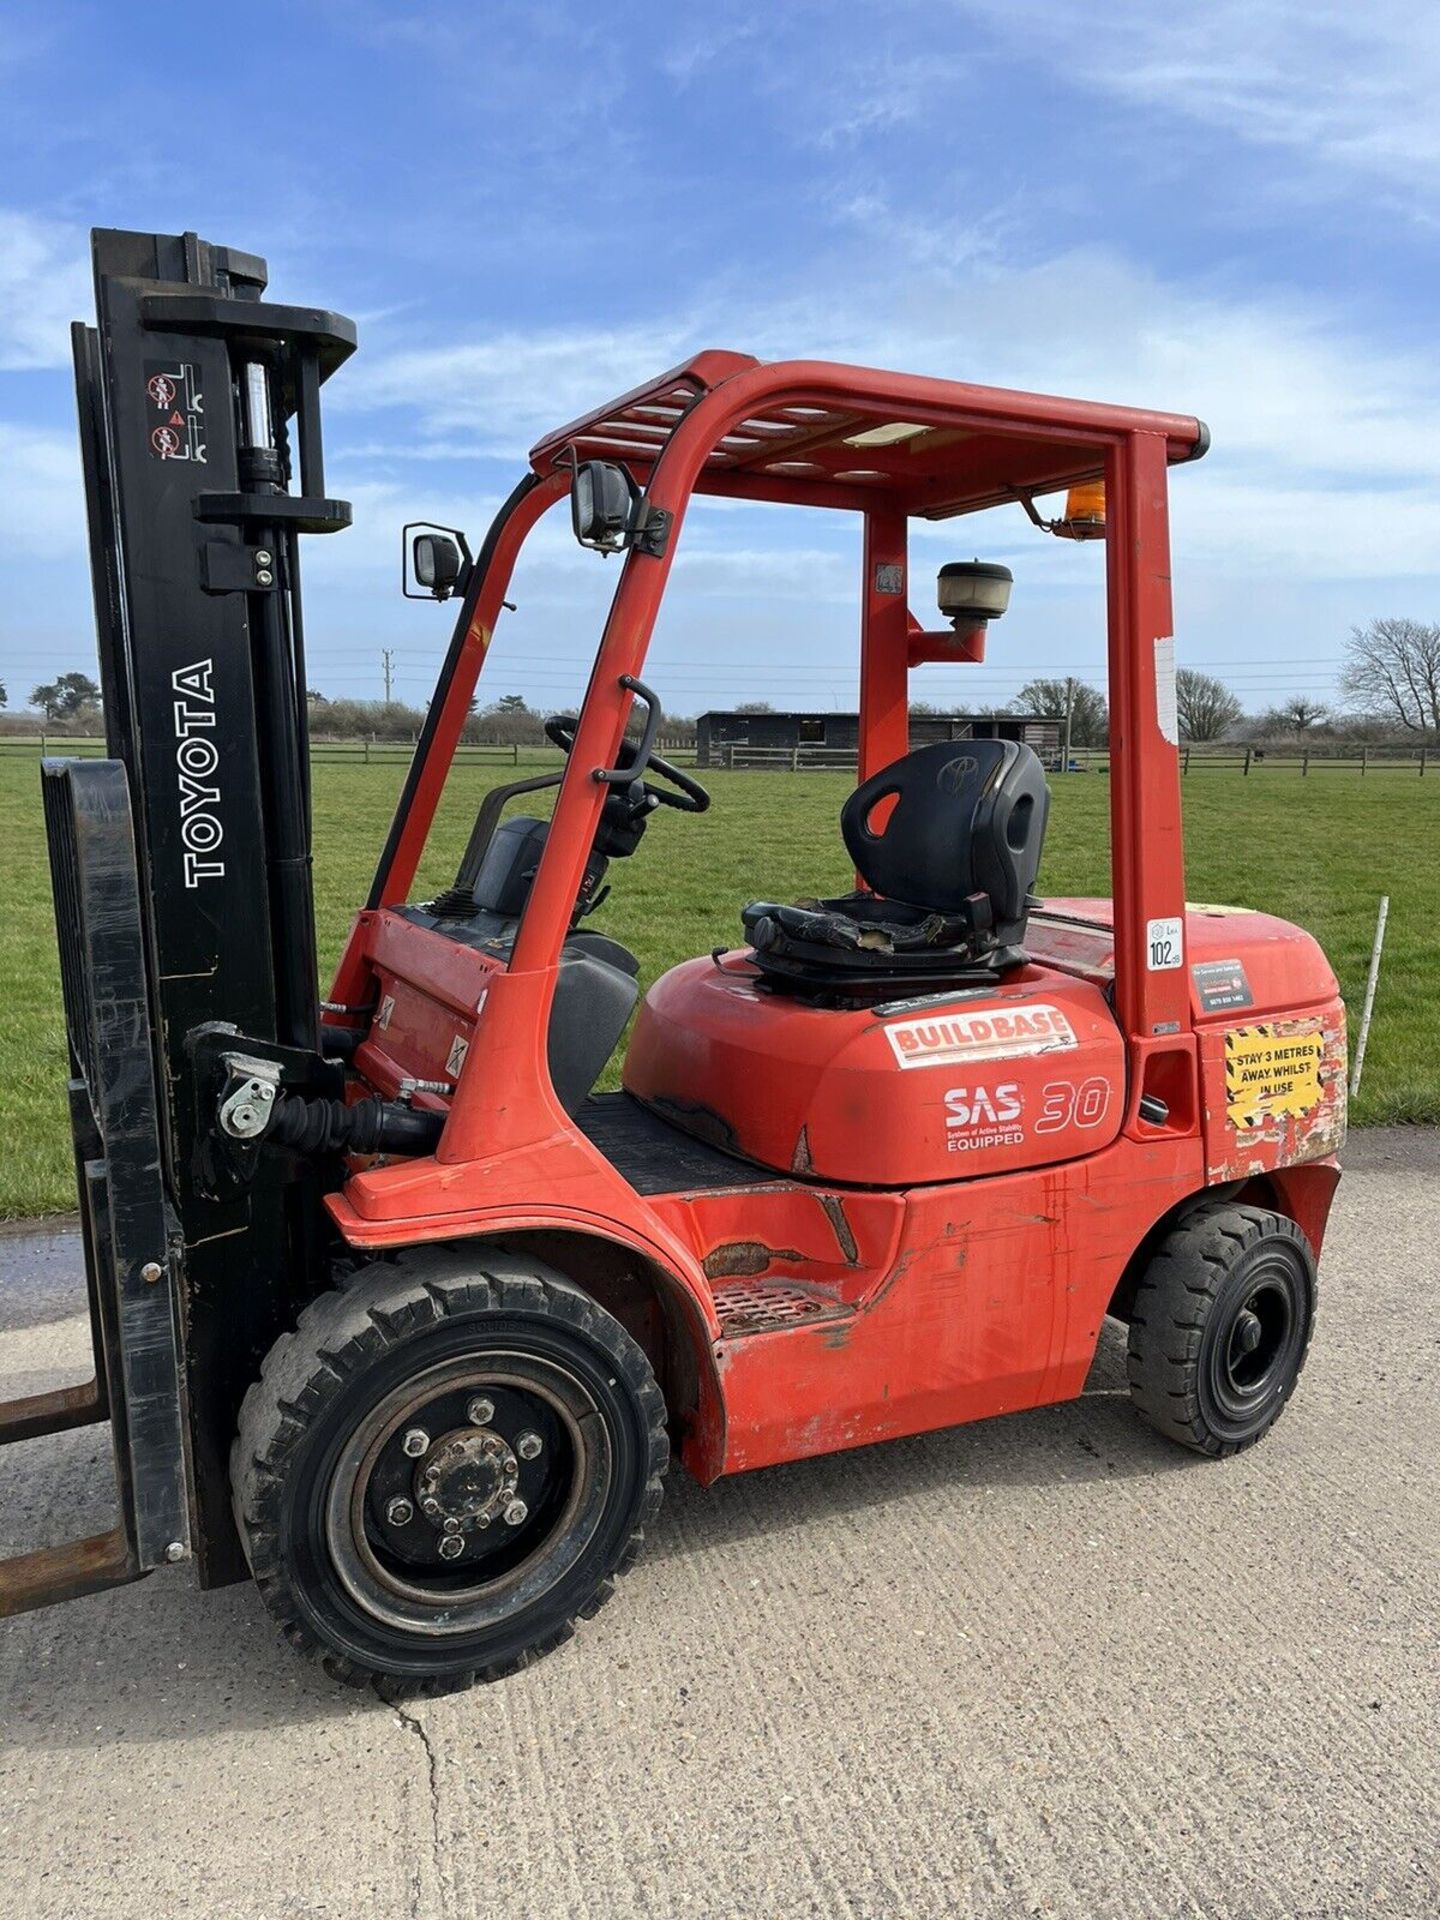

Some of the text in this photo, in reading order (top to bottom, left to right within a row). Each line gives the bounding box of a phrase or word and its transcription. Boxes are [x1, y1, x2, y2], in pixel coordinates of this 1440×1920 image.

[172, 658, 225, 888] TOYOTA
[1150, 940, 1171, 966] 102
[894, 1011, 1066, 1051] BUILDBASE
[1236, 1045, 1314, 1066] STAY 3 METRES
[1241, 1061, 1312, 1083] AWAY WHILST
[1260, 1081, 1294, 1094] IN USE
[943, 1083, 1021, 1128] SAS
[1035, 1076, 1111, 1134] 30
[947, 1131, 1025, 1152] EQUIPPED
